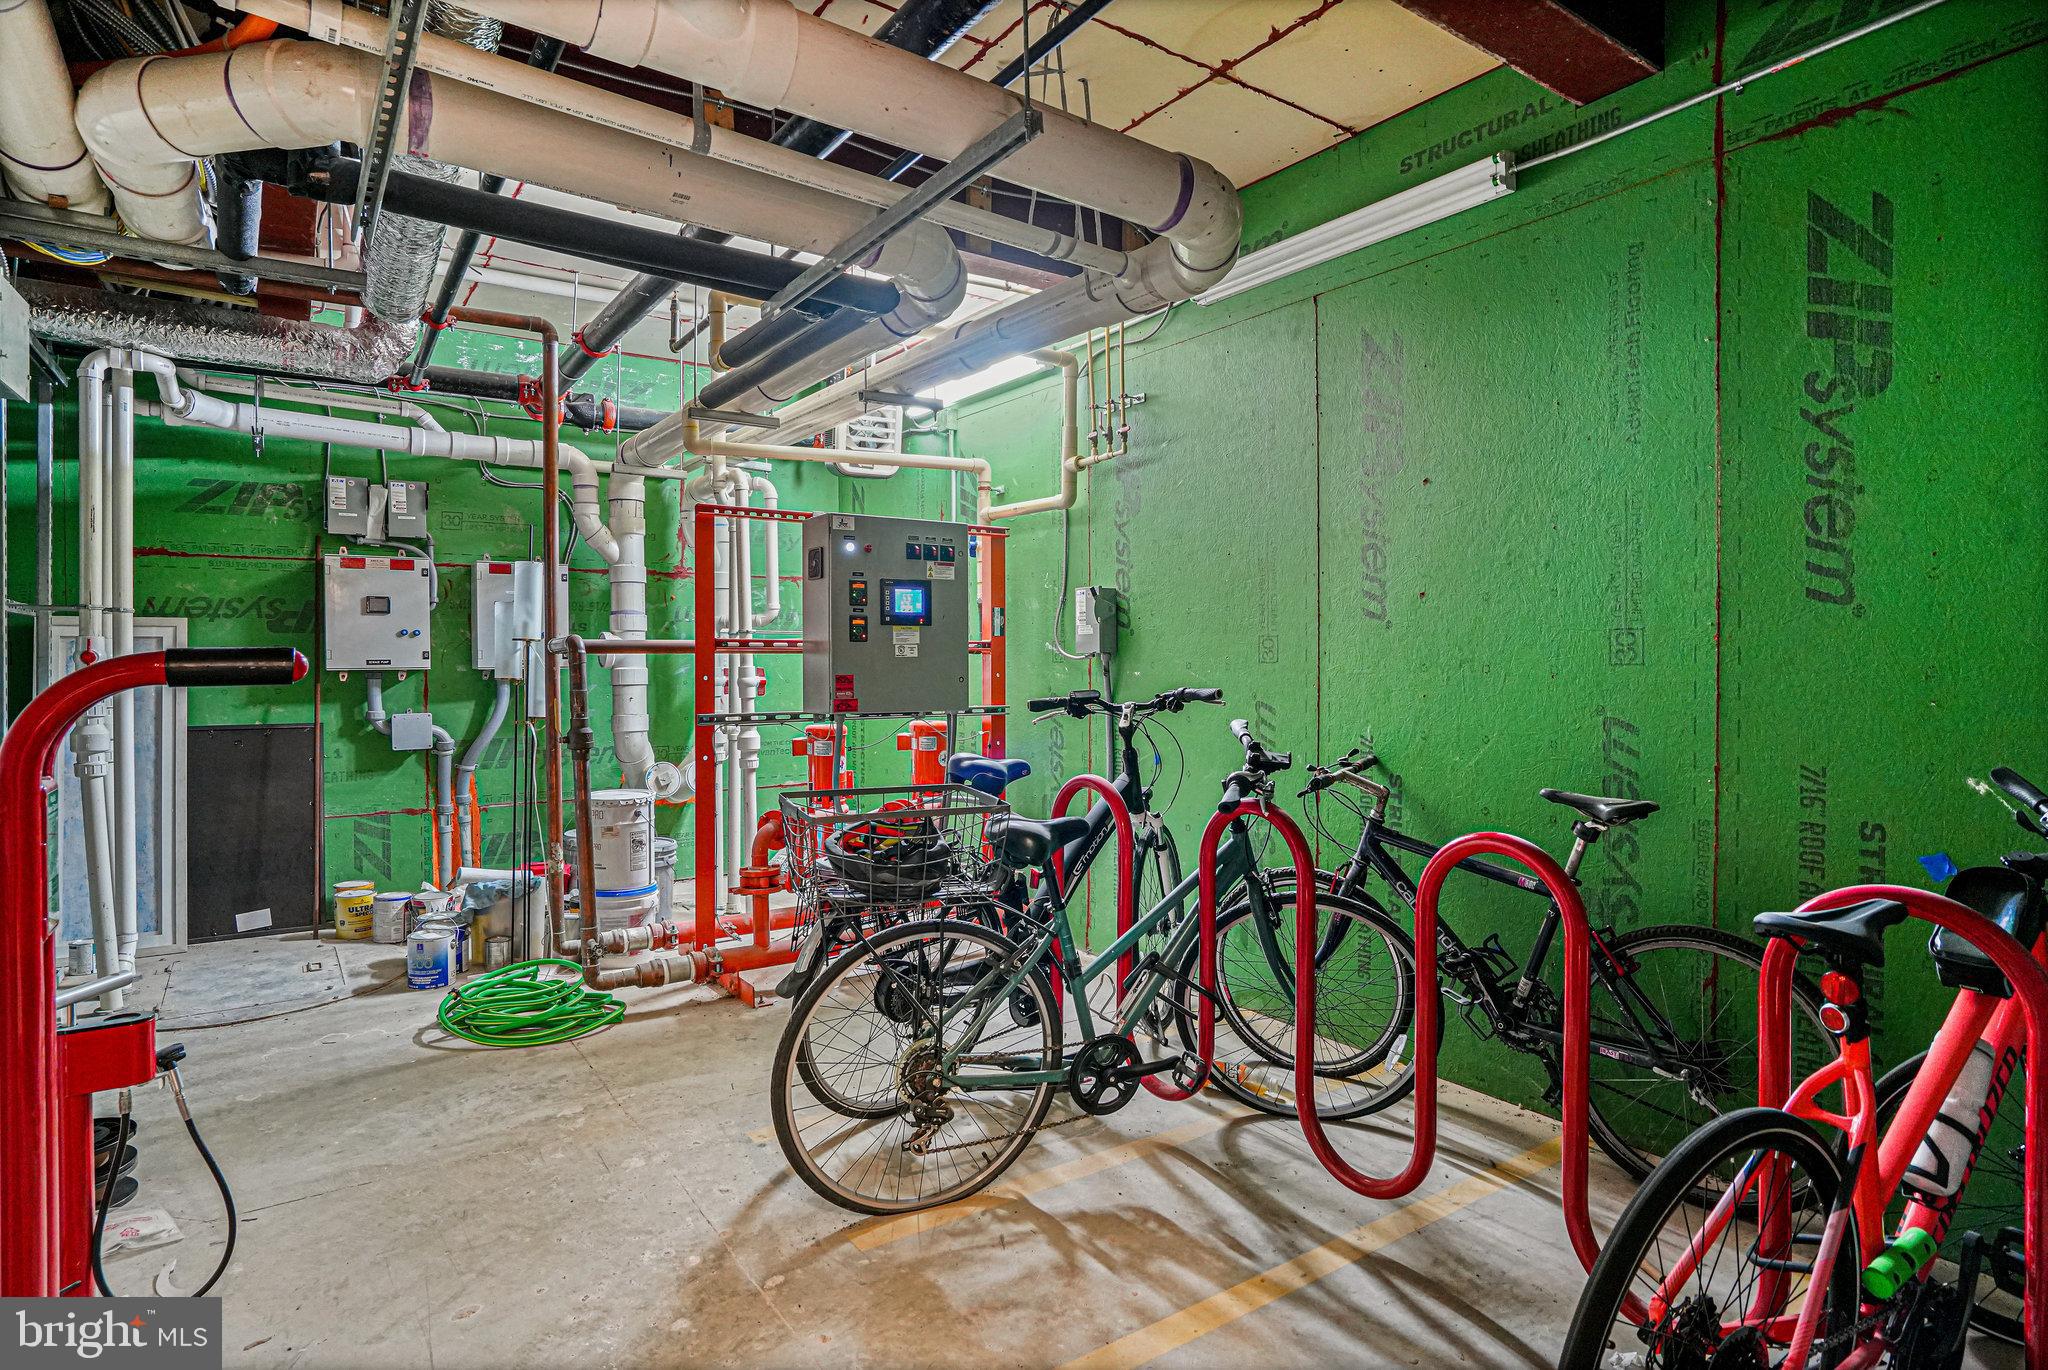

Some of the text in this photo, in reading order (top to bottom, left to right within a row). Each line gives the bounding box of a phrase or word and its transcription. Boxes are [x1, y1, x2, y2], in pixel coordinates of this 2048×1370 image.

[1399, 97, 1554, 175] STRUCTURAL
[1262, 636, 1275, 661] 30
[1799, 821, 1826, 880] ROOF
